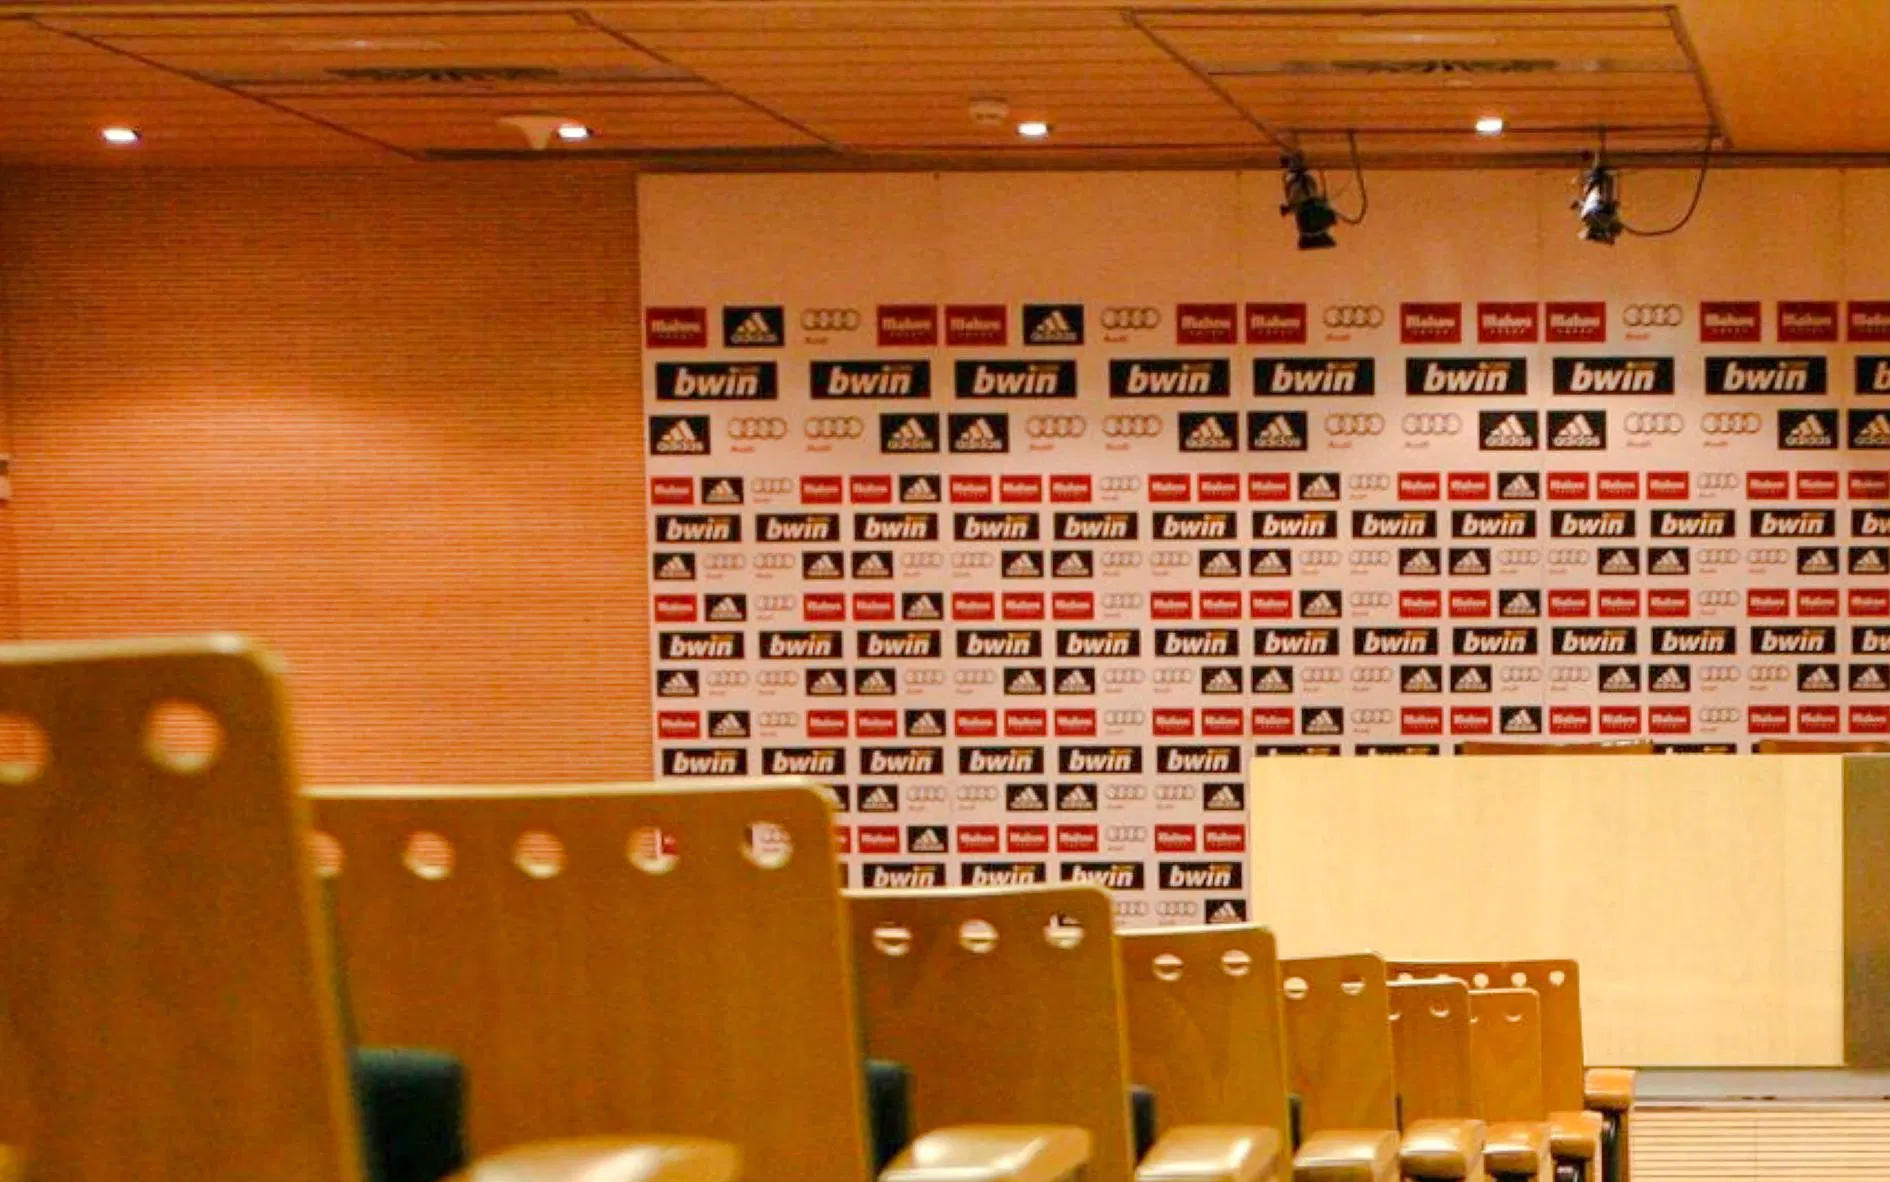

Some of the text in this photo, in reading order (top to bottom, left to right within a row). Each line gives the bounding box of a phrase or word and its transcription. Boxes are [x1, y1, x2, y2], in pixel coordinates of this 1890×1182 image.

[674, 367, 758, 396] bwin
[828, 365, 911, 395] bwin
[974, 364, 1057, 394] bwin
[1127, 363, 1210, 393] bwin
[1272, 362, 1355, 392] bwin
[1424, 361, 1508, 391] bwin
[1570, 361, 1655, 391] bwin
[1724, 361, 1807, 391] bwin
[666, 517, 729, 539] bwin
[766, 516, 829, 538] bwin
[865, 516, 928, 538] bwin
[964, 515, 1027, 537] bwin
[1064, 515, 1128, 537] bwin
[1163, 514, 1226, 536] bwin
[1263, 513, 1326, 535] bwin
[1362, 513, 1425, 535] bwin
[1462, 512, 1525, 534] bwin
[1561, 512, 1624, 534] bwin
[1661, 512, 1724, 534] bwin
[1761, 512, 1825, 534] bwin
[670, 634, 733, 656] bwin
[770, 634, 833, 656] bwin
[868, 633, 931, 655] bwin
[967, 632, 1030, 654] bwin
[1067, 632, 1129, 654] bwin
[1165, 632, 1229, 654] bwin
[1265, 630, 1327, 652] bwin
[1364, 630, 1427, 652] bwin
[1463, 630, 1526, 652] bwin
[1562, 629, 1625, 651] bwin
[1661, 629, 1724, 651] bwin
[1761, 629, 1824, 651] bwin
[673, 750, 736, 772] bwin
[772, 750, 836, 772] bwin
[870, 750, 934, 772] bwin
[970, 749, 1032, 771] bwin
[1069, 748, 1131, 770] bwin
[1167, 748, 1229, 770] bwin
[873, 864, 935, 887] bwin
[1169, 864, 1231, 886] bwin
